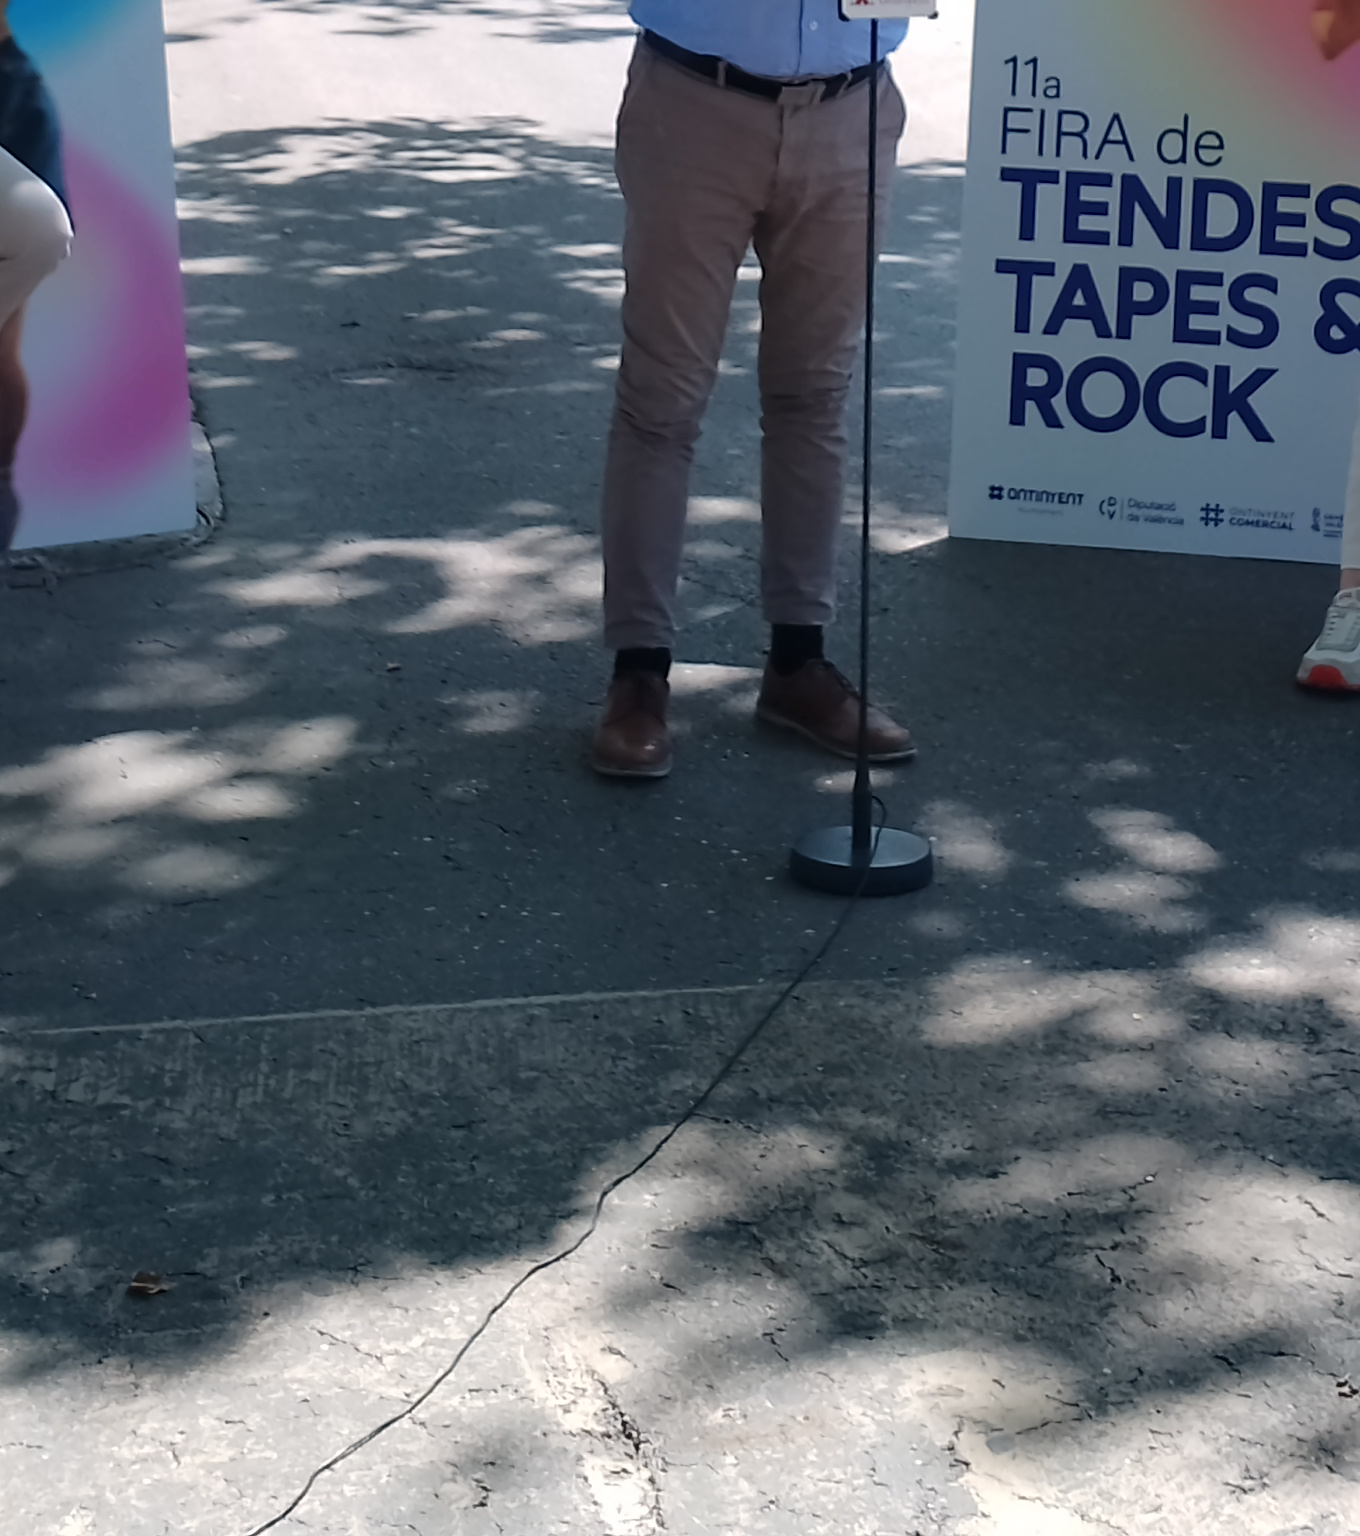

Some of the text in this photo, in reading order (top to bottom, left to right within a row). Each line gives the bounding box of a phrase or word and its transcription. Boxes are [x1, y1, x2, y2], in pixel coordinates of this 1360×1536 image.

[1004, 55, 1061, 99] 11a
[1000, 106, 1225, 166] FIRA de
[995, 258, 1279, 349] TAPES
[1009, 352, 1279, 442] ROCK
[1007, 487, 1084, 506] ONTINYENT
[1229, 517, 1294, 531] COMERCIAL
